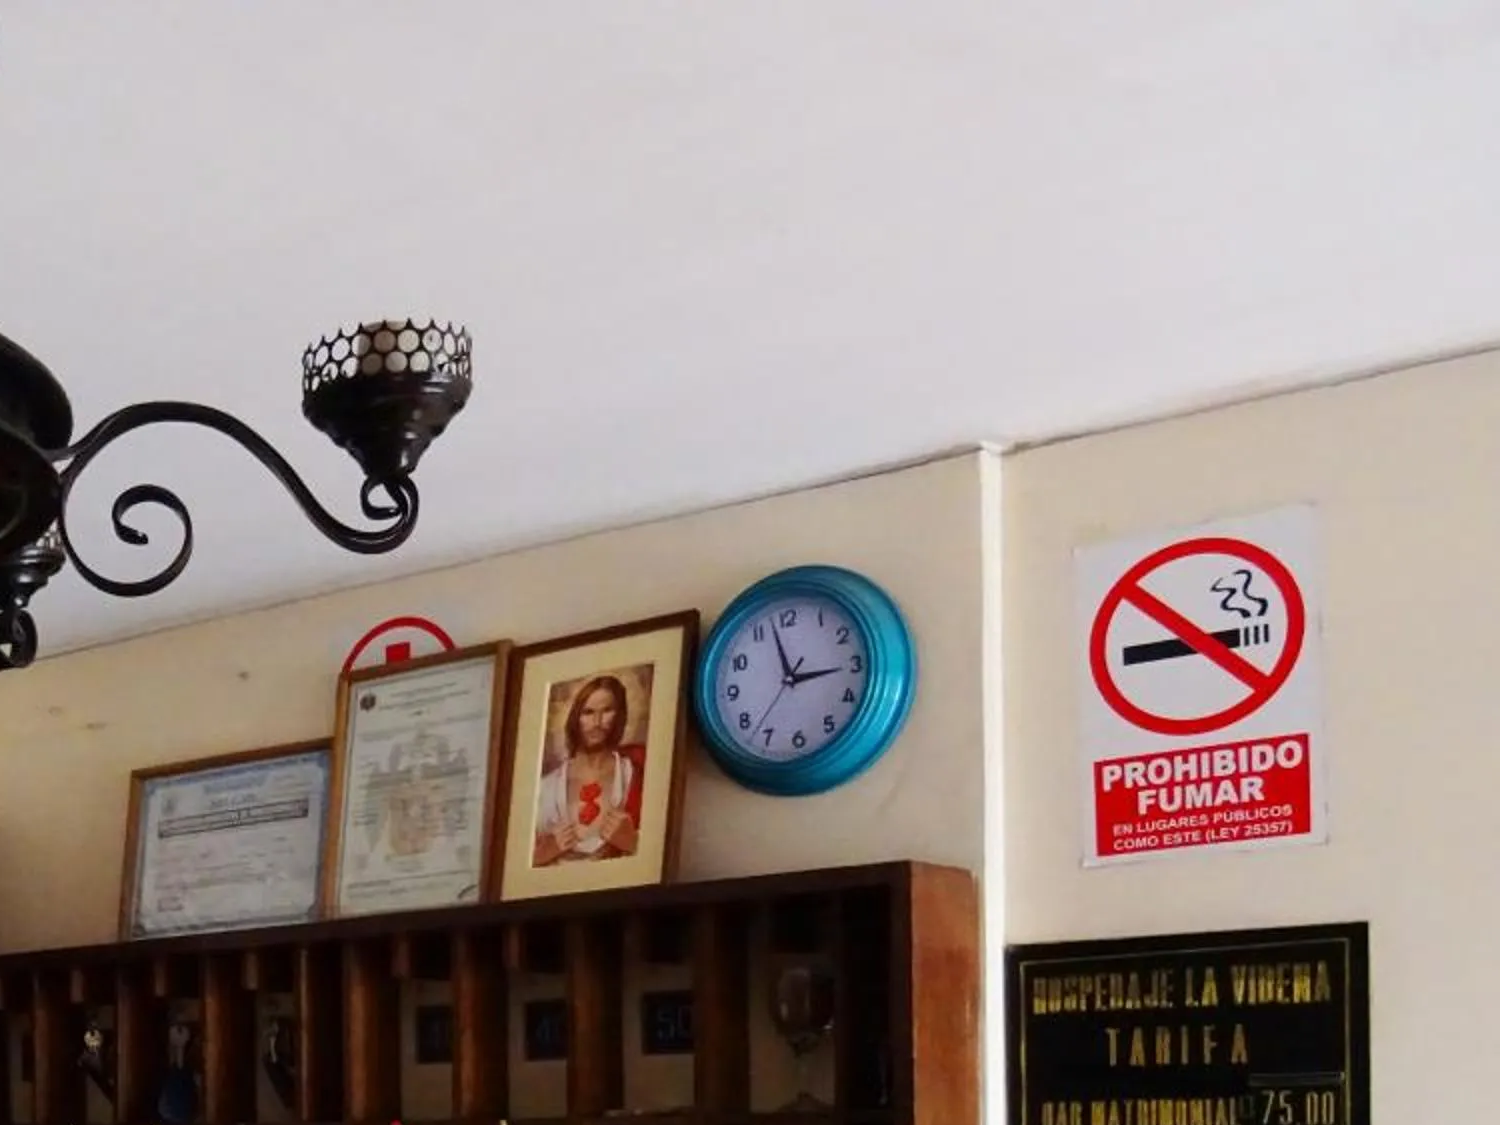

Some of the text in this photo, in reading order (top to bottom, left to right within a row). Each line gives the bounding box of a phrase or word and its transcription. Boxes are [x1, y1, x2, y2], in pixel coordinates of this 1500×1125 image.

[778, 608, 797, 629] 12
[817, 607, 824, 627] 1
[753, 626, 764, 643] 11
[836, 626, 850, 645] 2
[732, 653, 748, 673] 10
[850, 655, 862, 674] 3
[727, 685, 740, 701] 9
[841, 687, 855, 703] 4
[739, 712, 751, 730] 8
[823, 715, 835, 734] 5
[762, 728, 775, 747] 7
[791, 730, 806, 748] 6
[1102, 740, 1303, 792] PROHIBIDO
[1137, 776, 1265, 816] FUMAR
[1112, 823, 1132, 837] EN
[1136, 813, 1209, 833] LUGARES
[1113, 834, 1159, 851] COMO
[1163, 830, 1201, 845] ESTE
[1205, 825, 1242, 843] (LEY
[1032, 968, 1175, 1015] HOSPEDAJE
[1184, 966, 1219, 1008] LA
